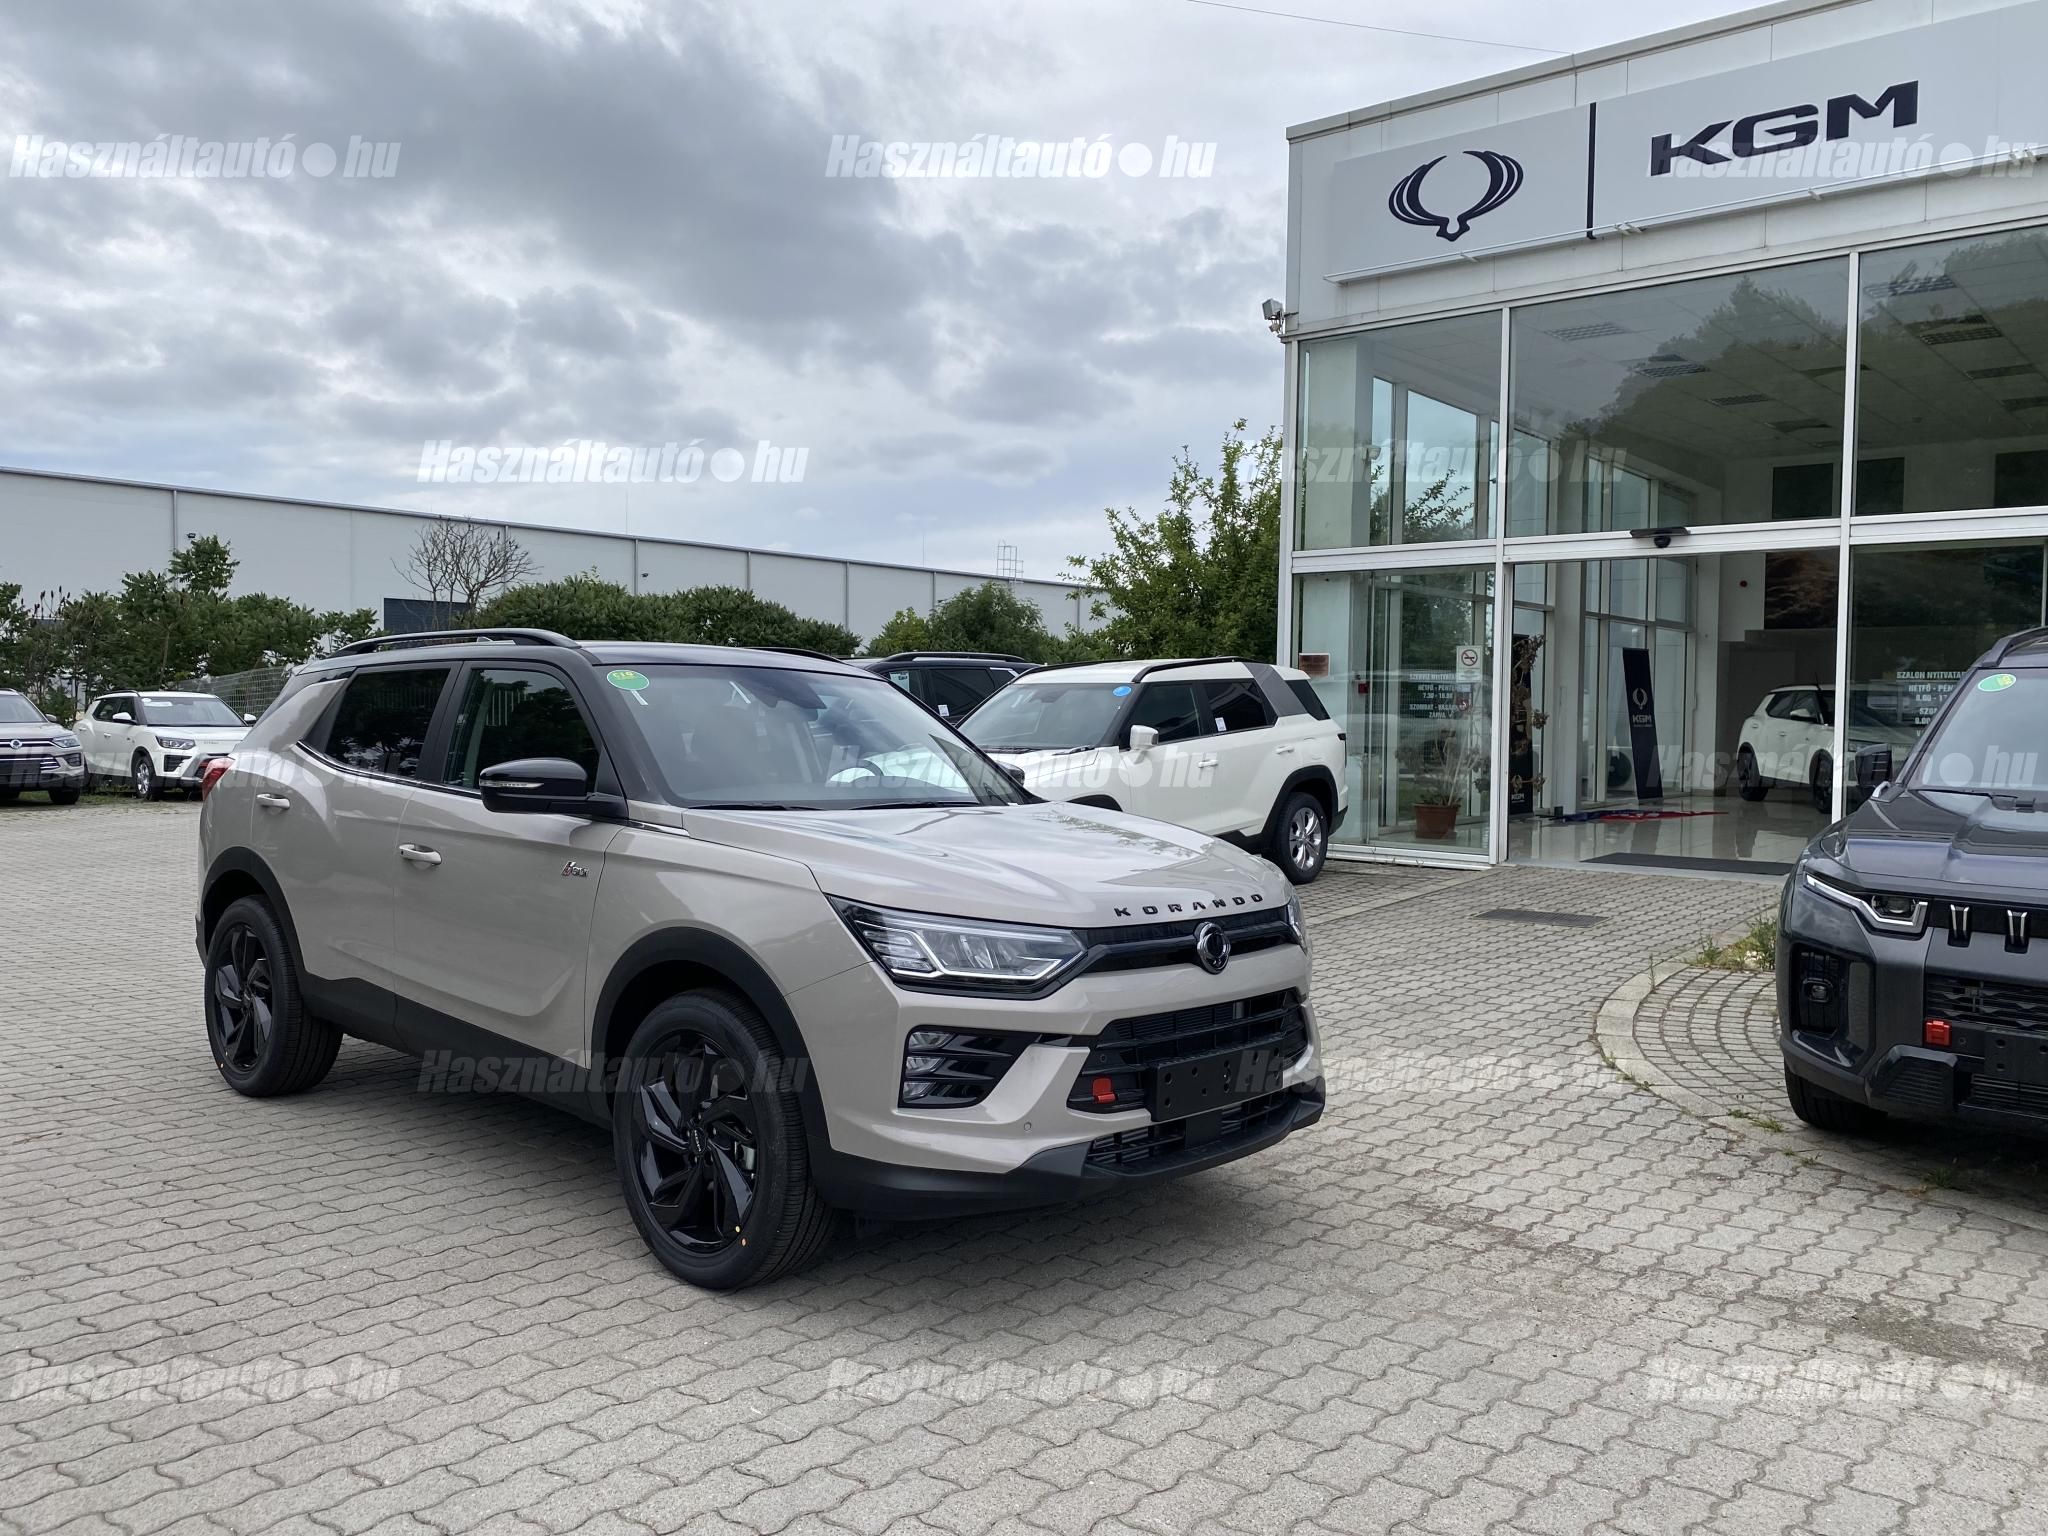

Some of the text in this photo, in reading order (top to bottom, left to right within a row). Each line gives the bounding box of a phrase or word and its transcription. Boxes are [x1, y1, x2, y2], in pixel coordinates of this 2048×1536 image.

[1651, 80, 1919, 177] KGM
[1632, 714, 1652, 723] KGM
[1114, 894, 1264, 917] KORANDO
